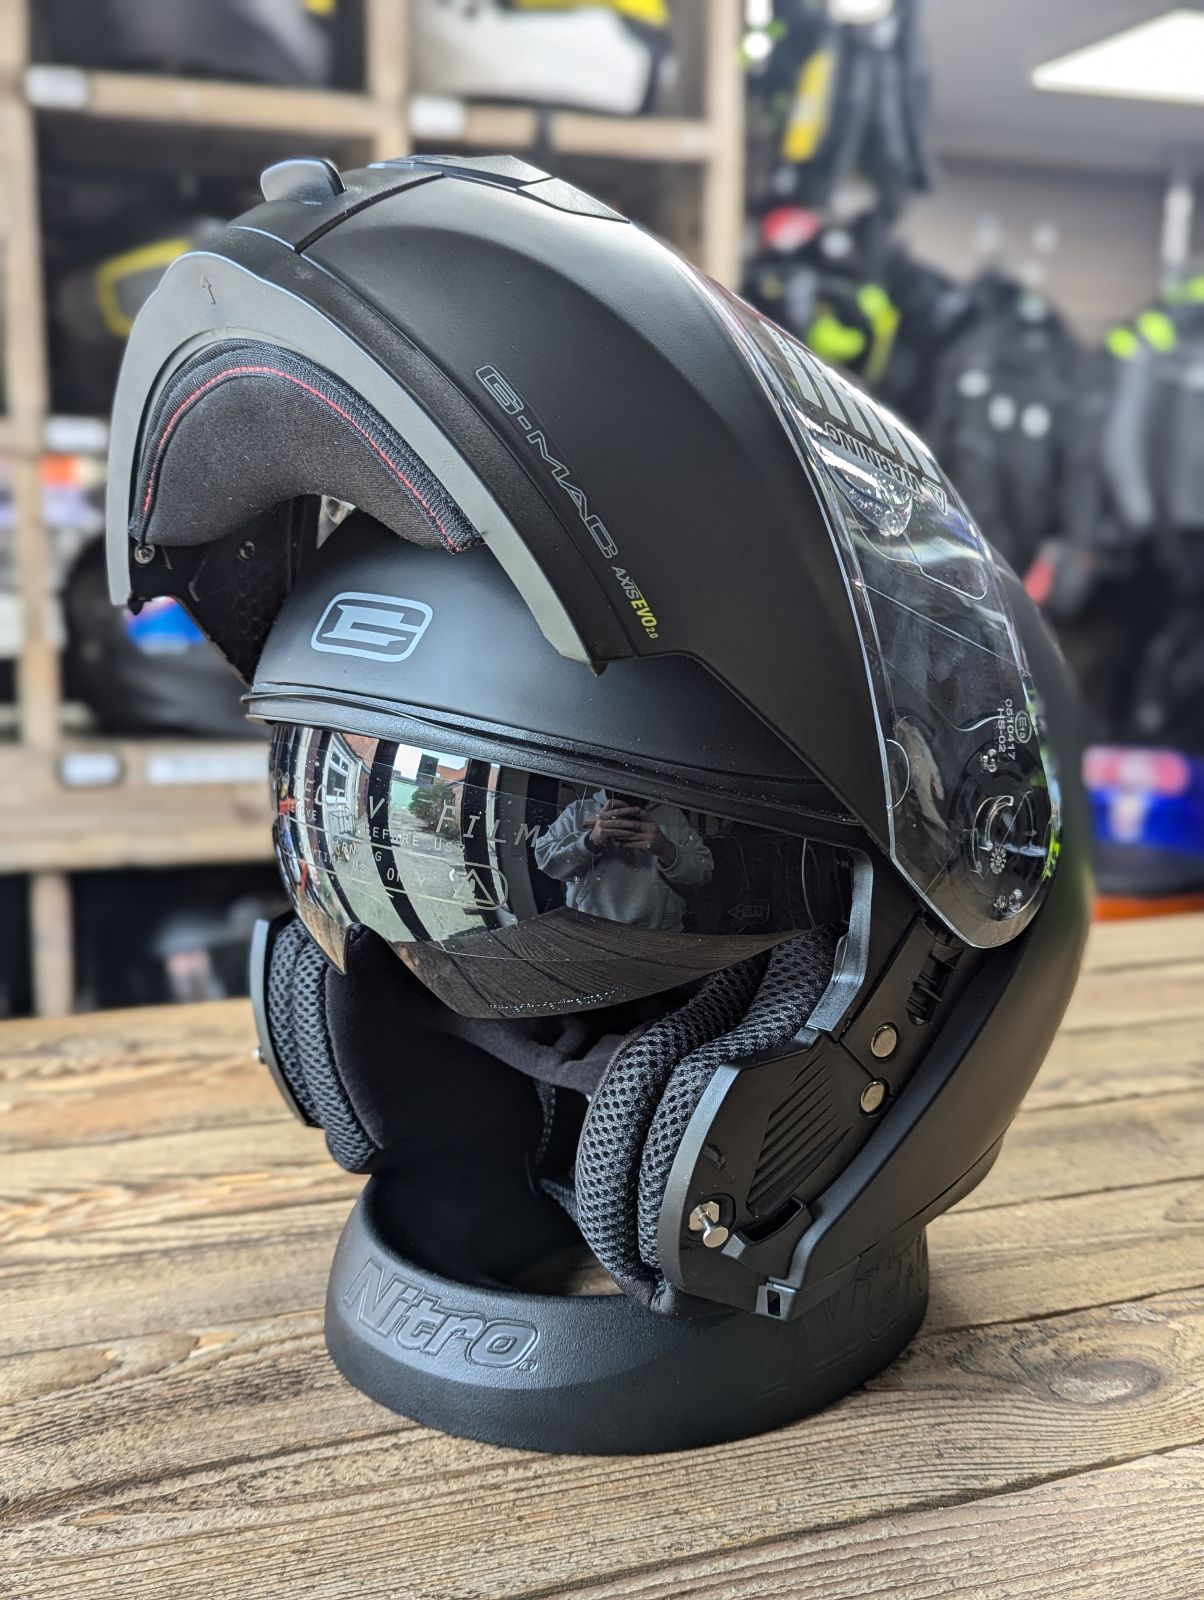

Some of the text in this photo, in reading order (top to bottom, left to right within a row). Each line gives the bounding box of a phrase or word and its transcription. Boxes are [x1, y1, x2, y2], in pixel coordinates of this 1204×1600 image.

[475, 364, 619, 560] G-MAC
[823, 421, 925, 496] WARNING
[996, 707, 1006, 753] HS-02
[436, 802, 541, 848] FILM
[343, 1255, 540, 1369] Nitro
